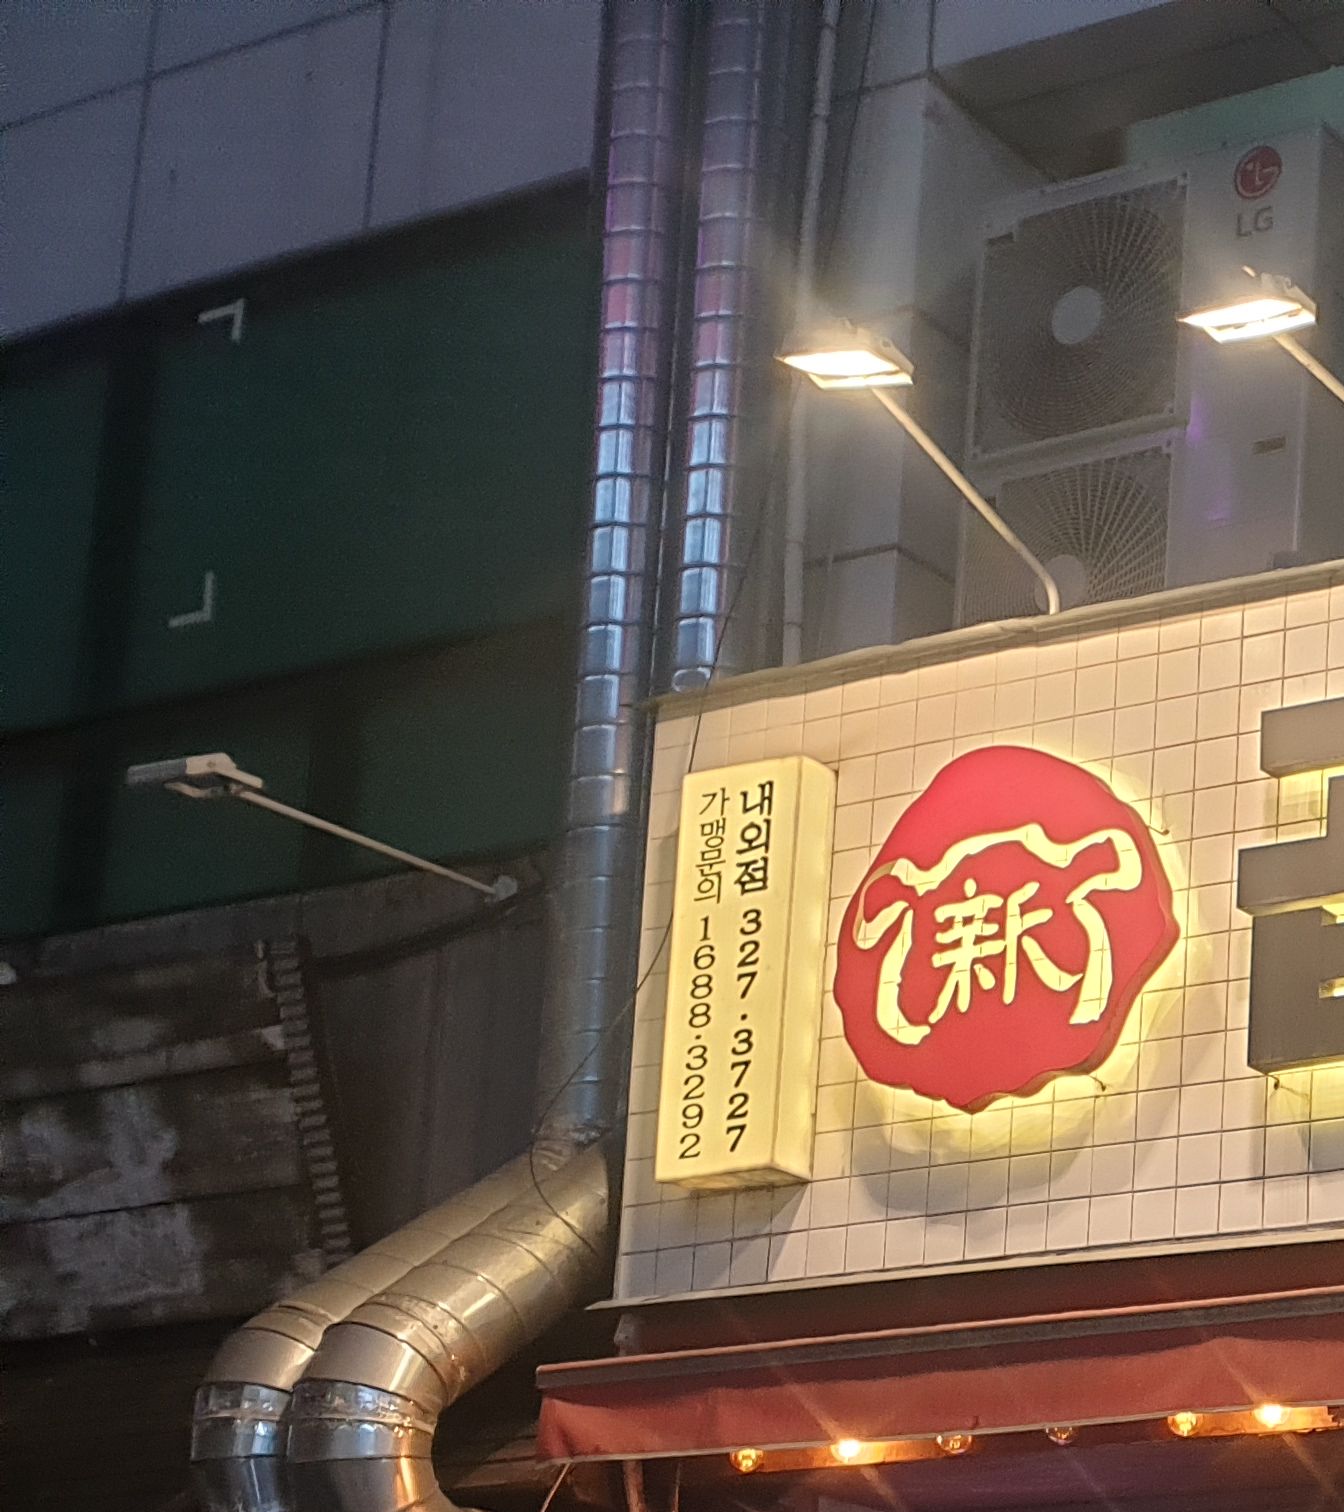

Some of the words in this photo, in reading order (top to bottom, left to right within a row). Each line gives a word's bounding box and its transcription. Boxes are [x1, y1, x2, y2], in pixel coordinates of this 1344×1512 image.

[1236, 206, 1274, 238] LG
[693, 786, 731, 904] 가맹문의
[733, 780, 774, 896] 내외점
